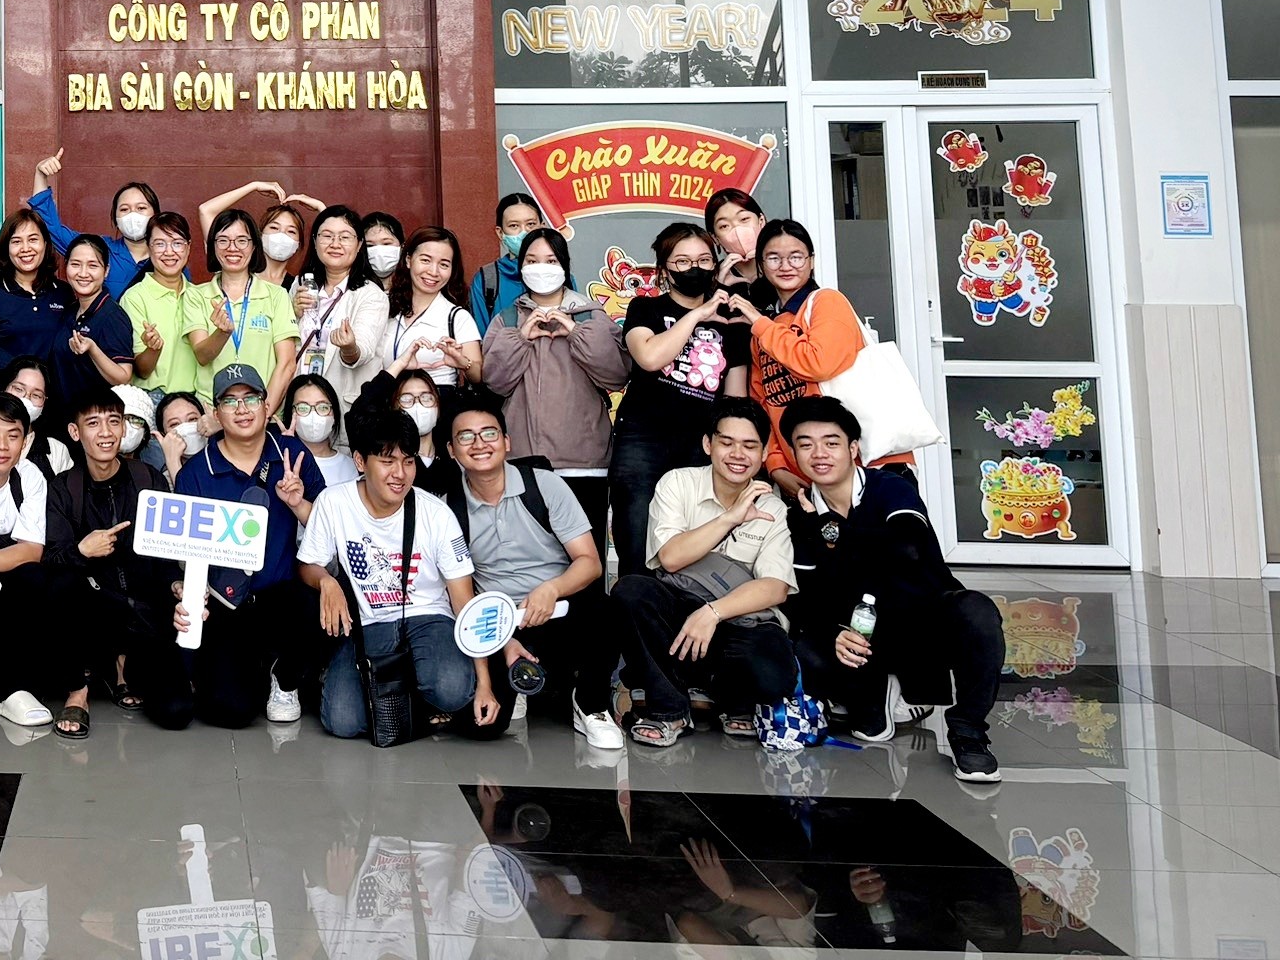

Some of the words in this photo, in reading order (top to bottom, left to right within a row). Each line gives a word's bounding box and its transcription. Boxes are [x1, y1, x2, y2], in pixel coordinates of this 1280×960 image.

[200, 3, 239, 42] TY
[503, 6, 619, 56] NEW
[627, 3, 760, 52] YEAR!
[68, 72, 113, 112] BIA
[120, 62, 164, 112] SÀI
[173, 60, 234, 112] GÒN
[257, 60, 356, 110] KHÁNH
[366, 60, 428, 110] HÒA
[545, 137, 633, 180] Chào
[572, 172, 612, 203] GIÁP
[620, 169, 661, 198] THÌN
[669, 173, 714, 202] 2024
[144, 496, 254, 546] iBEX
